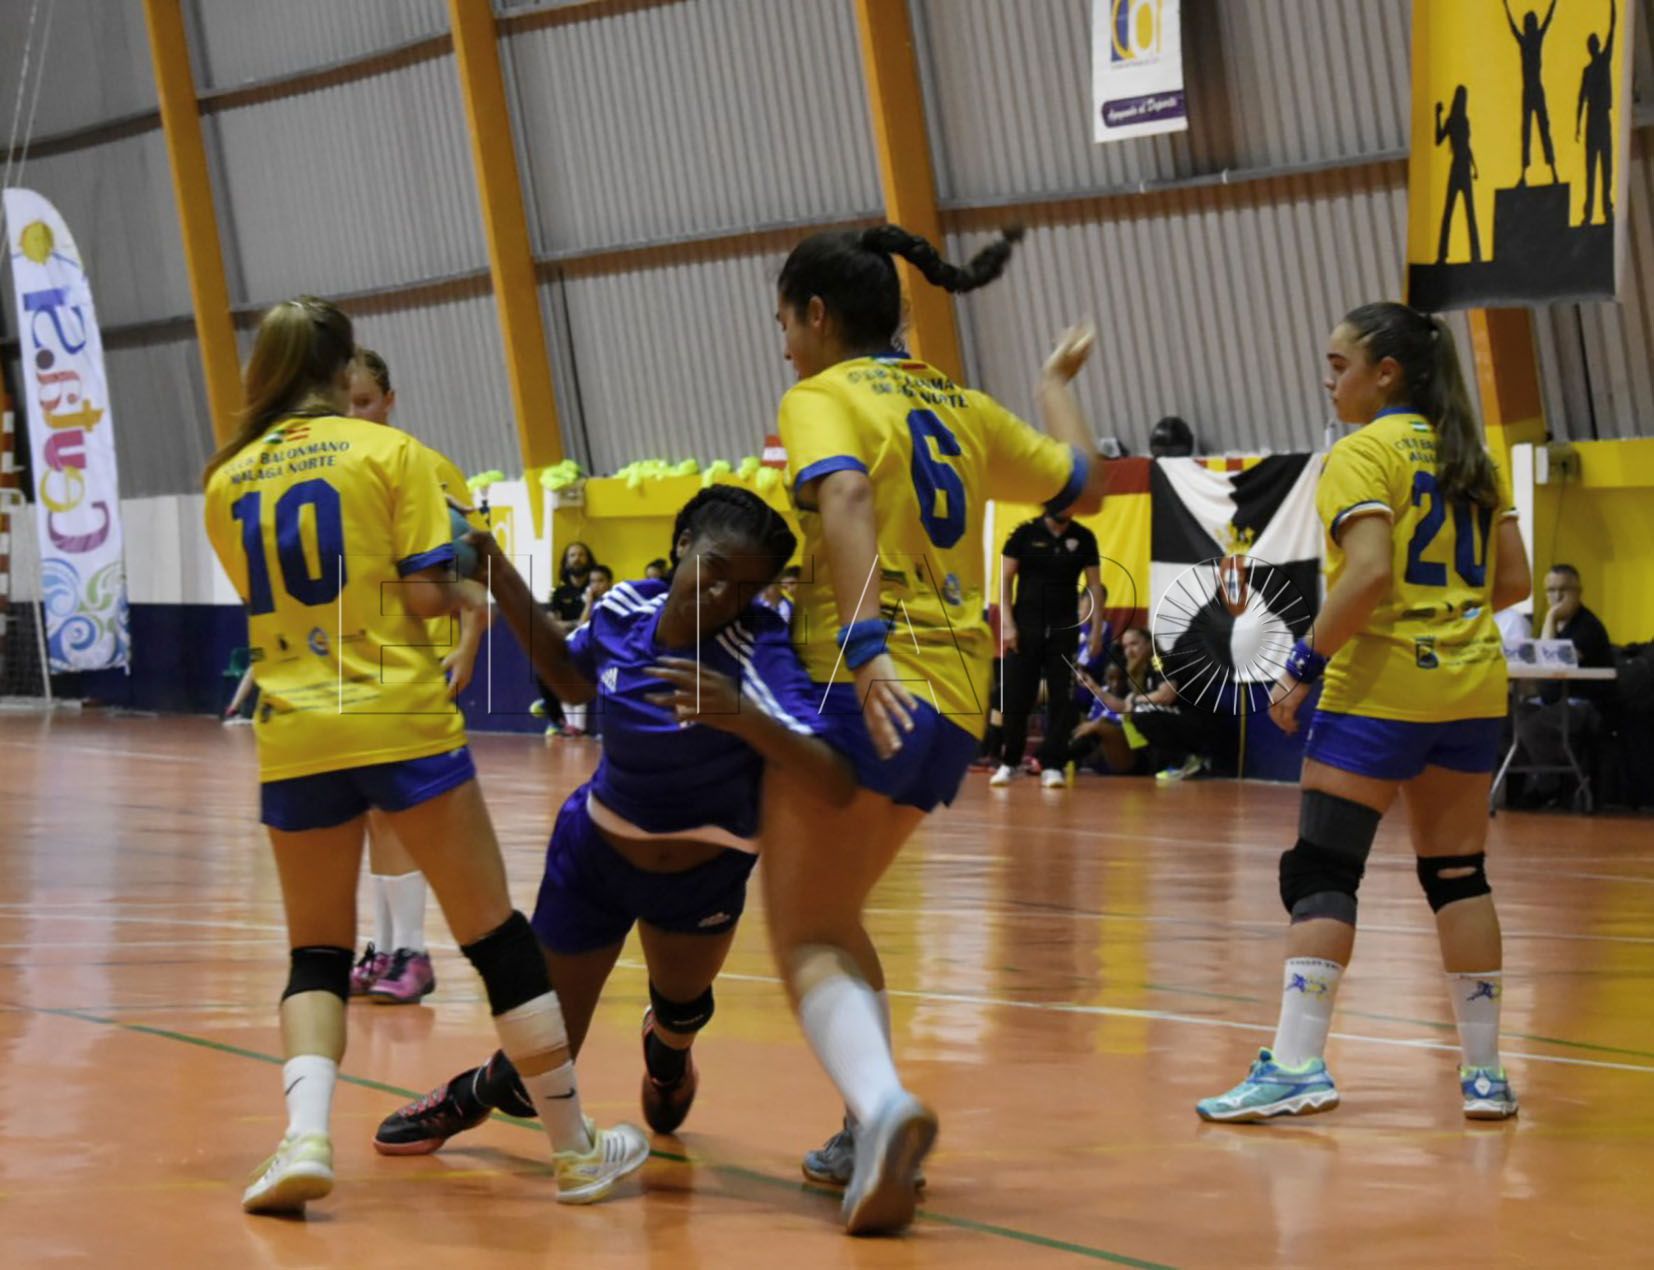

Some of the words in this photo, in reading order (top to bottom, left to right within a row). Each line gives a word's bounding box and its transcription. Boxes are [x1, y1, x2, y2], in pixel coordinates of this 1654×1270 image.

[288, 455, 336, 474] NORTE
[905, 407, 967, 549] 6
[1404, 470, 1494, 588] 20
[231, 477, 348, 617] 10
